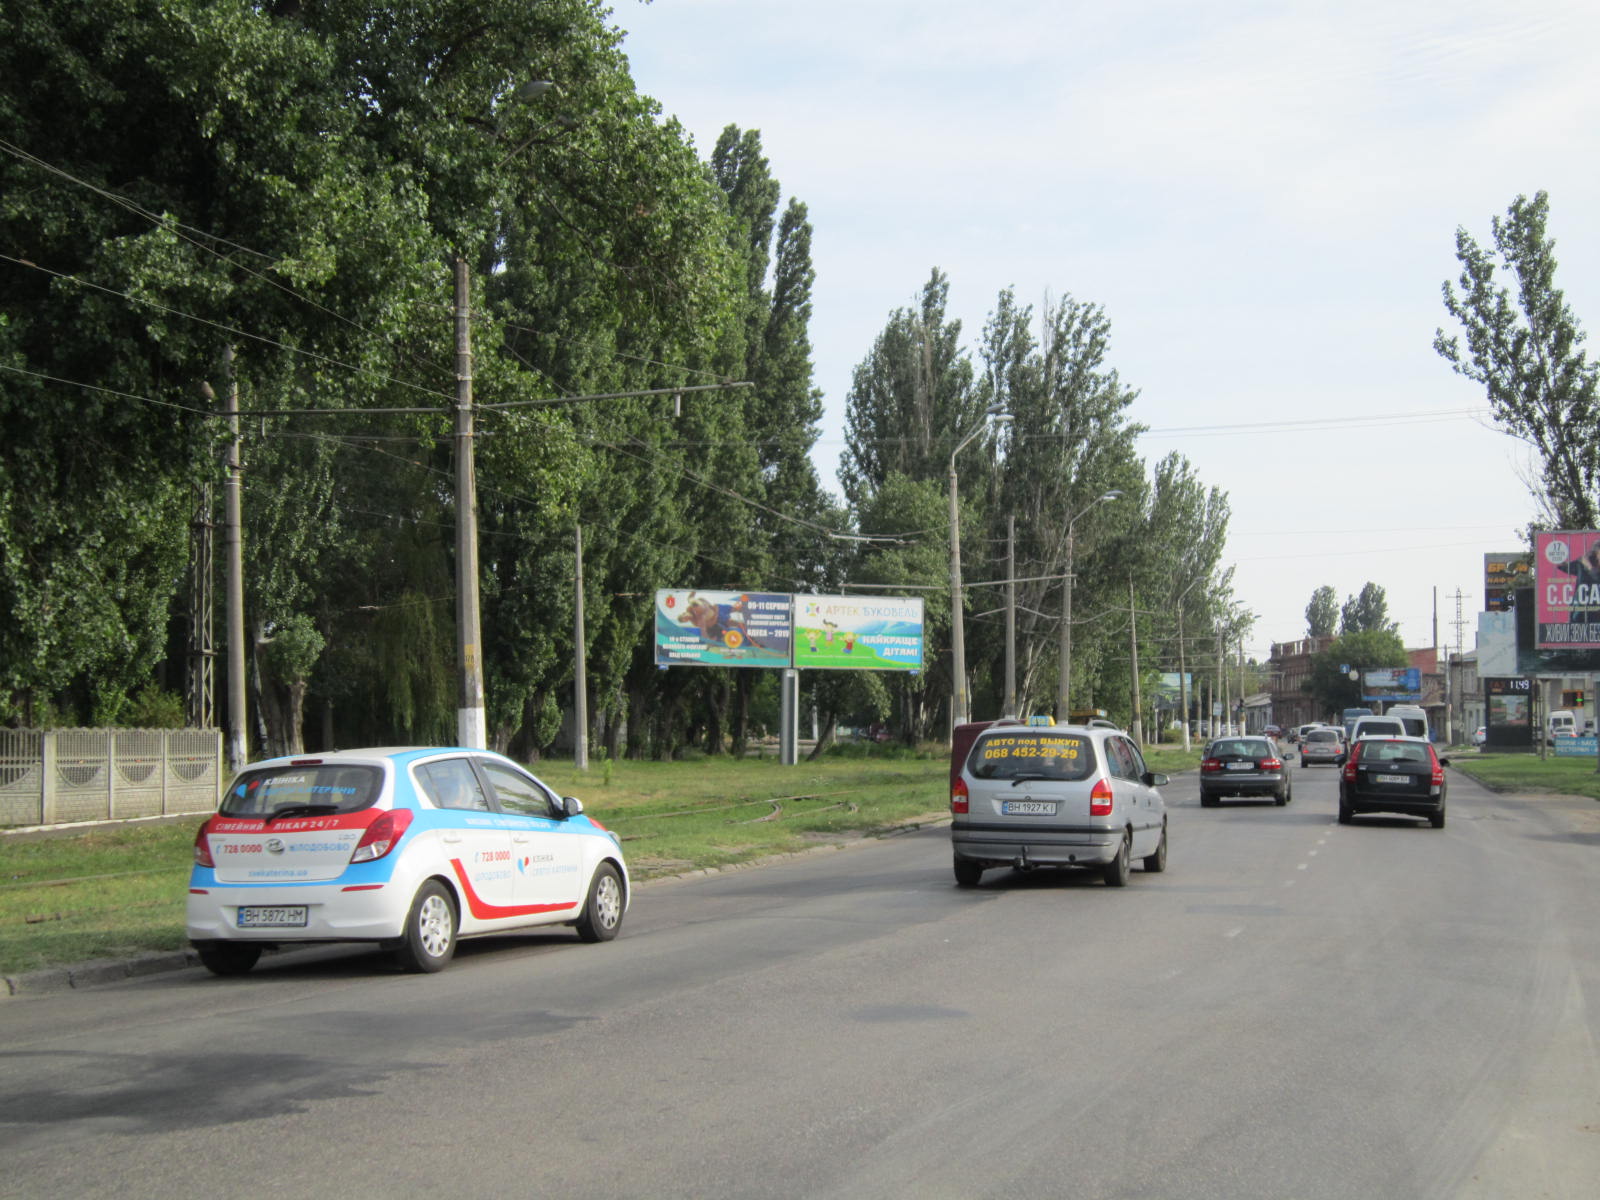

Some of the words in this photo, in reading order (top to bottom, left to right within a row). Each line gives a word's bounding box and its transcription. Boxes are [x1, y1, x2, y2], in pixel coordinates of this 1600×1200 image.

[826, 606, 859, 615] АРТЕК
[863, 635, 919, 646] НАЙКРАЩЕ
[986, 739, 1015, 747] АВТО
[1040, 738, 1080, 747] ВЫКУП
[985, 749, 1008, 759] 068
[246, 909, 260, 922] BH
[262, 909, 286, 922] 5872
